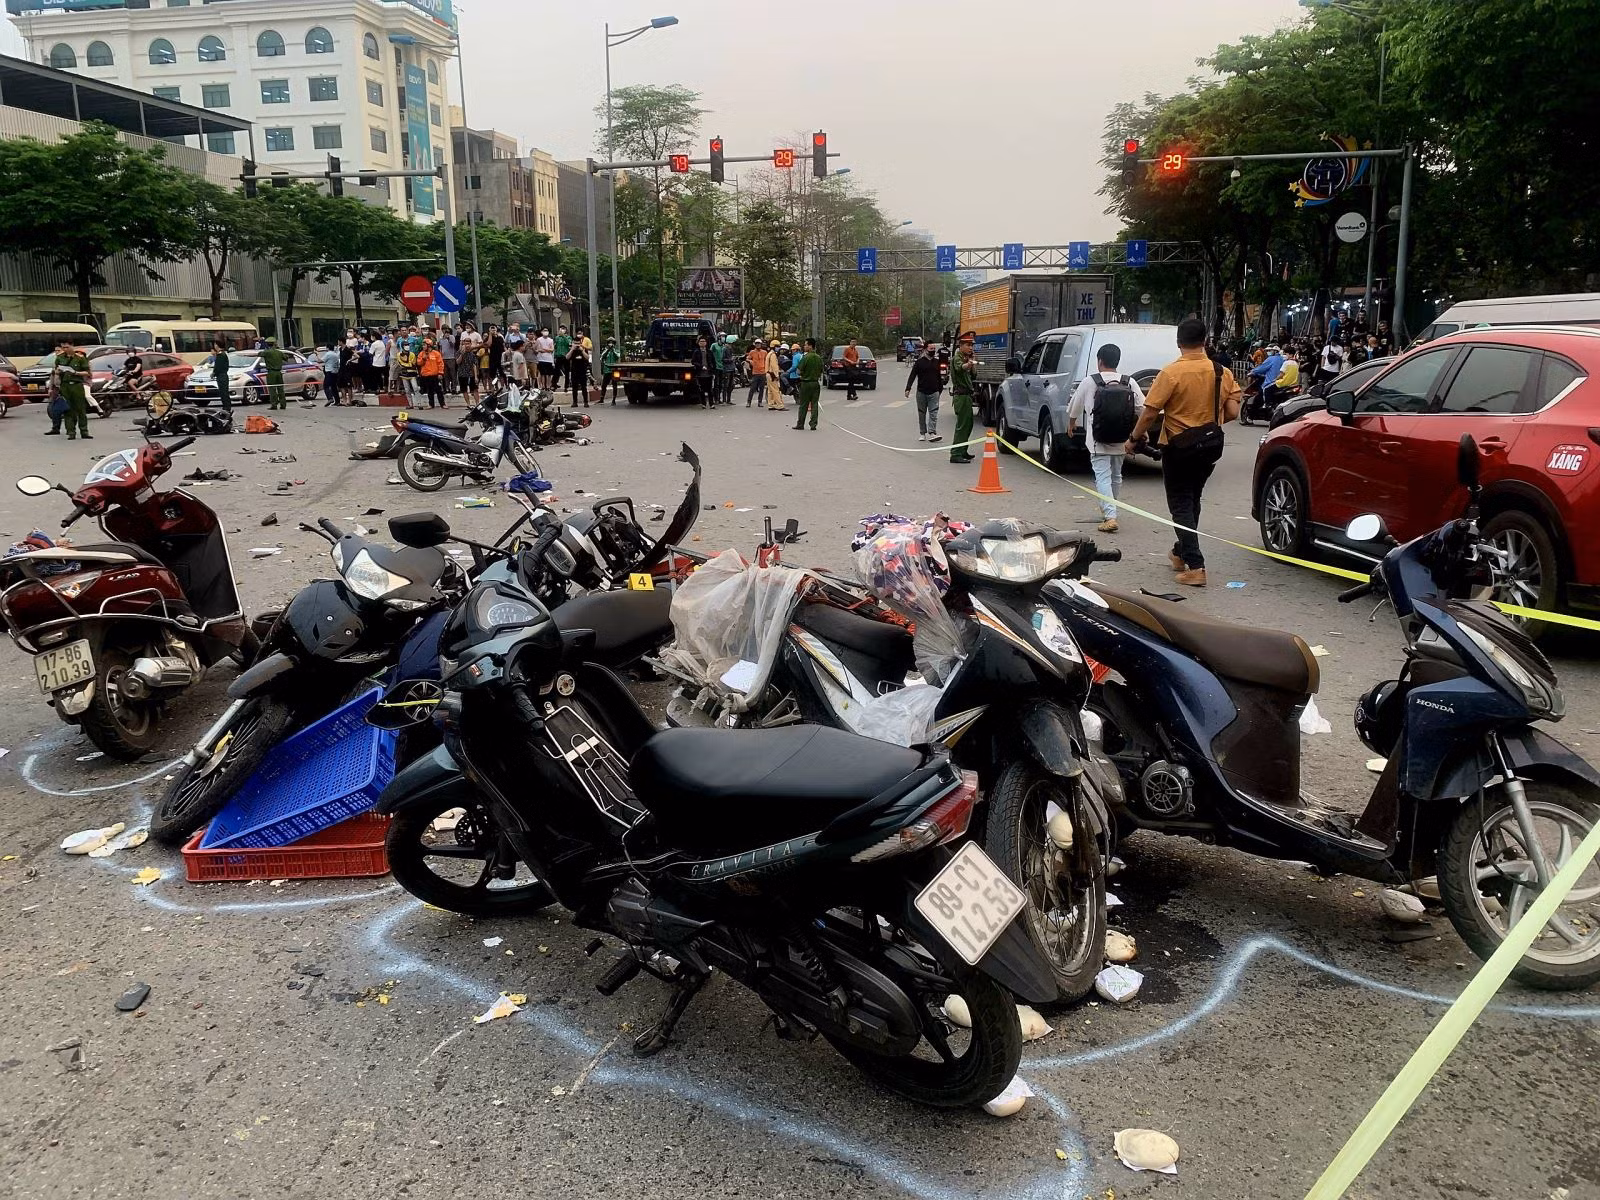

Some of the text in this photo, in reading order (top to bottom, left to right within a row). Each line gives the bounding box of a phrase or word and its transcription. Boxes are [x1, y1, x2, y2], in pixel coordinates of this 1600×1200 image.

[672, 157, 687, 171] 79
[775, 151, 792, 165] 29
[1163, 154, 1182, 170] 29
[1080, 292, 1093, 305] XE
[1076, 306, 1097, 321] THƯ
[1547, 450, 1583, 471] XĂNG
[638, 575, 647, 588] 4
[1071, 608, 1120, 636] VISION
[42, 644, 82, 671] 17-B6
[41, 659, 92, 691] 210.39
[1416, 698, 1455, 714] HONDA
[691, 842, 793, 877] GRAVITA
[928, 854, 989, 921] 89-C1
[950, 877, 1019, 954] 142.53
